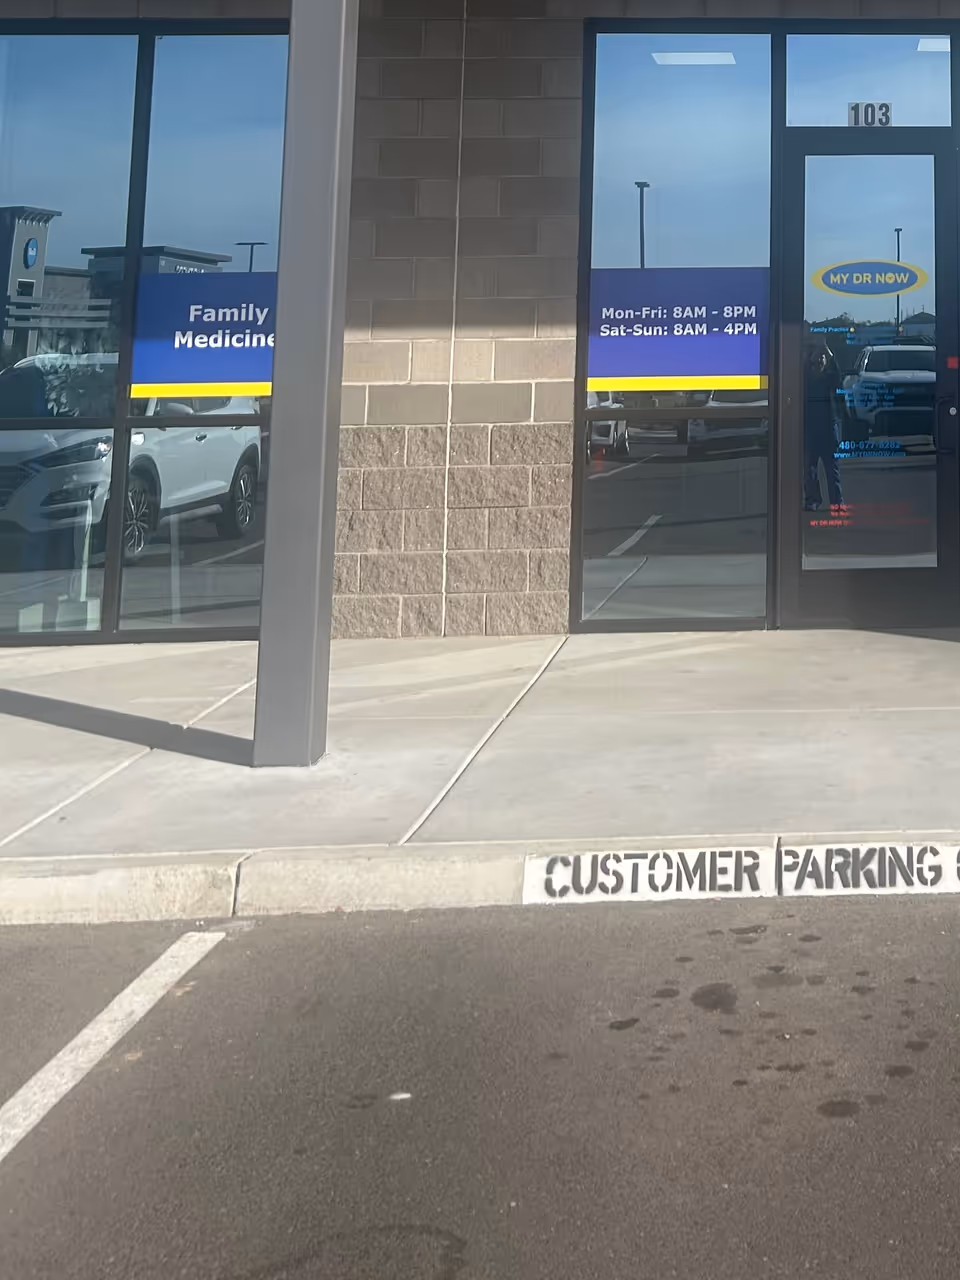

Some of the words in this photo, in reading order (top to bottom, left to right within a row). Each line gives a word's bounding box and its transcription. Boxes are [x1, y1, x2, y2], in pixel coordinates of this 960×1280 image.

[851, 102, 890, 126] 103
[830, 272, 849, 284] MY
[853, 272, 872, 284] DR
[875, 272, 910, 285] NOW
[188, 303, 270, 326] Family
[601, 306, 667, 319] Mon-Fri:
[672, 306, 707, 319] 8AM
[722, 306, 757, 318] 8PM
[600, 323, 668, 336] Sat-Sun:
[673, 323, 707, 336] 8AM
[723, 323, 757, 335] 4PM
[544, 849, 760, 898] CUSTOMER
[779, 845, 943, 891] PARKING
